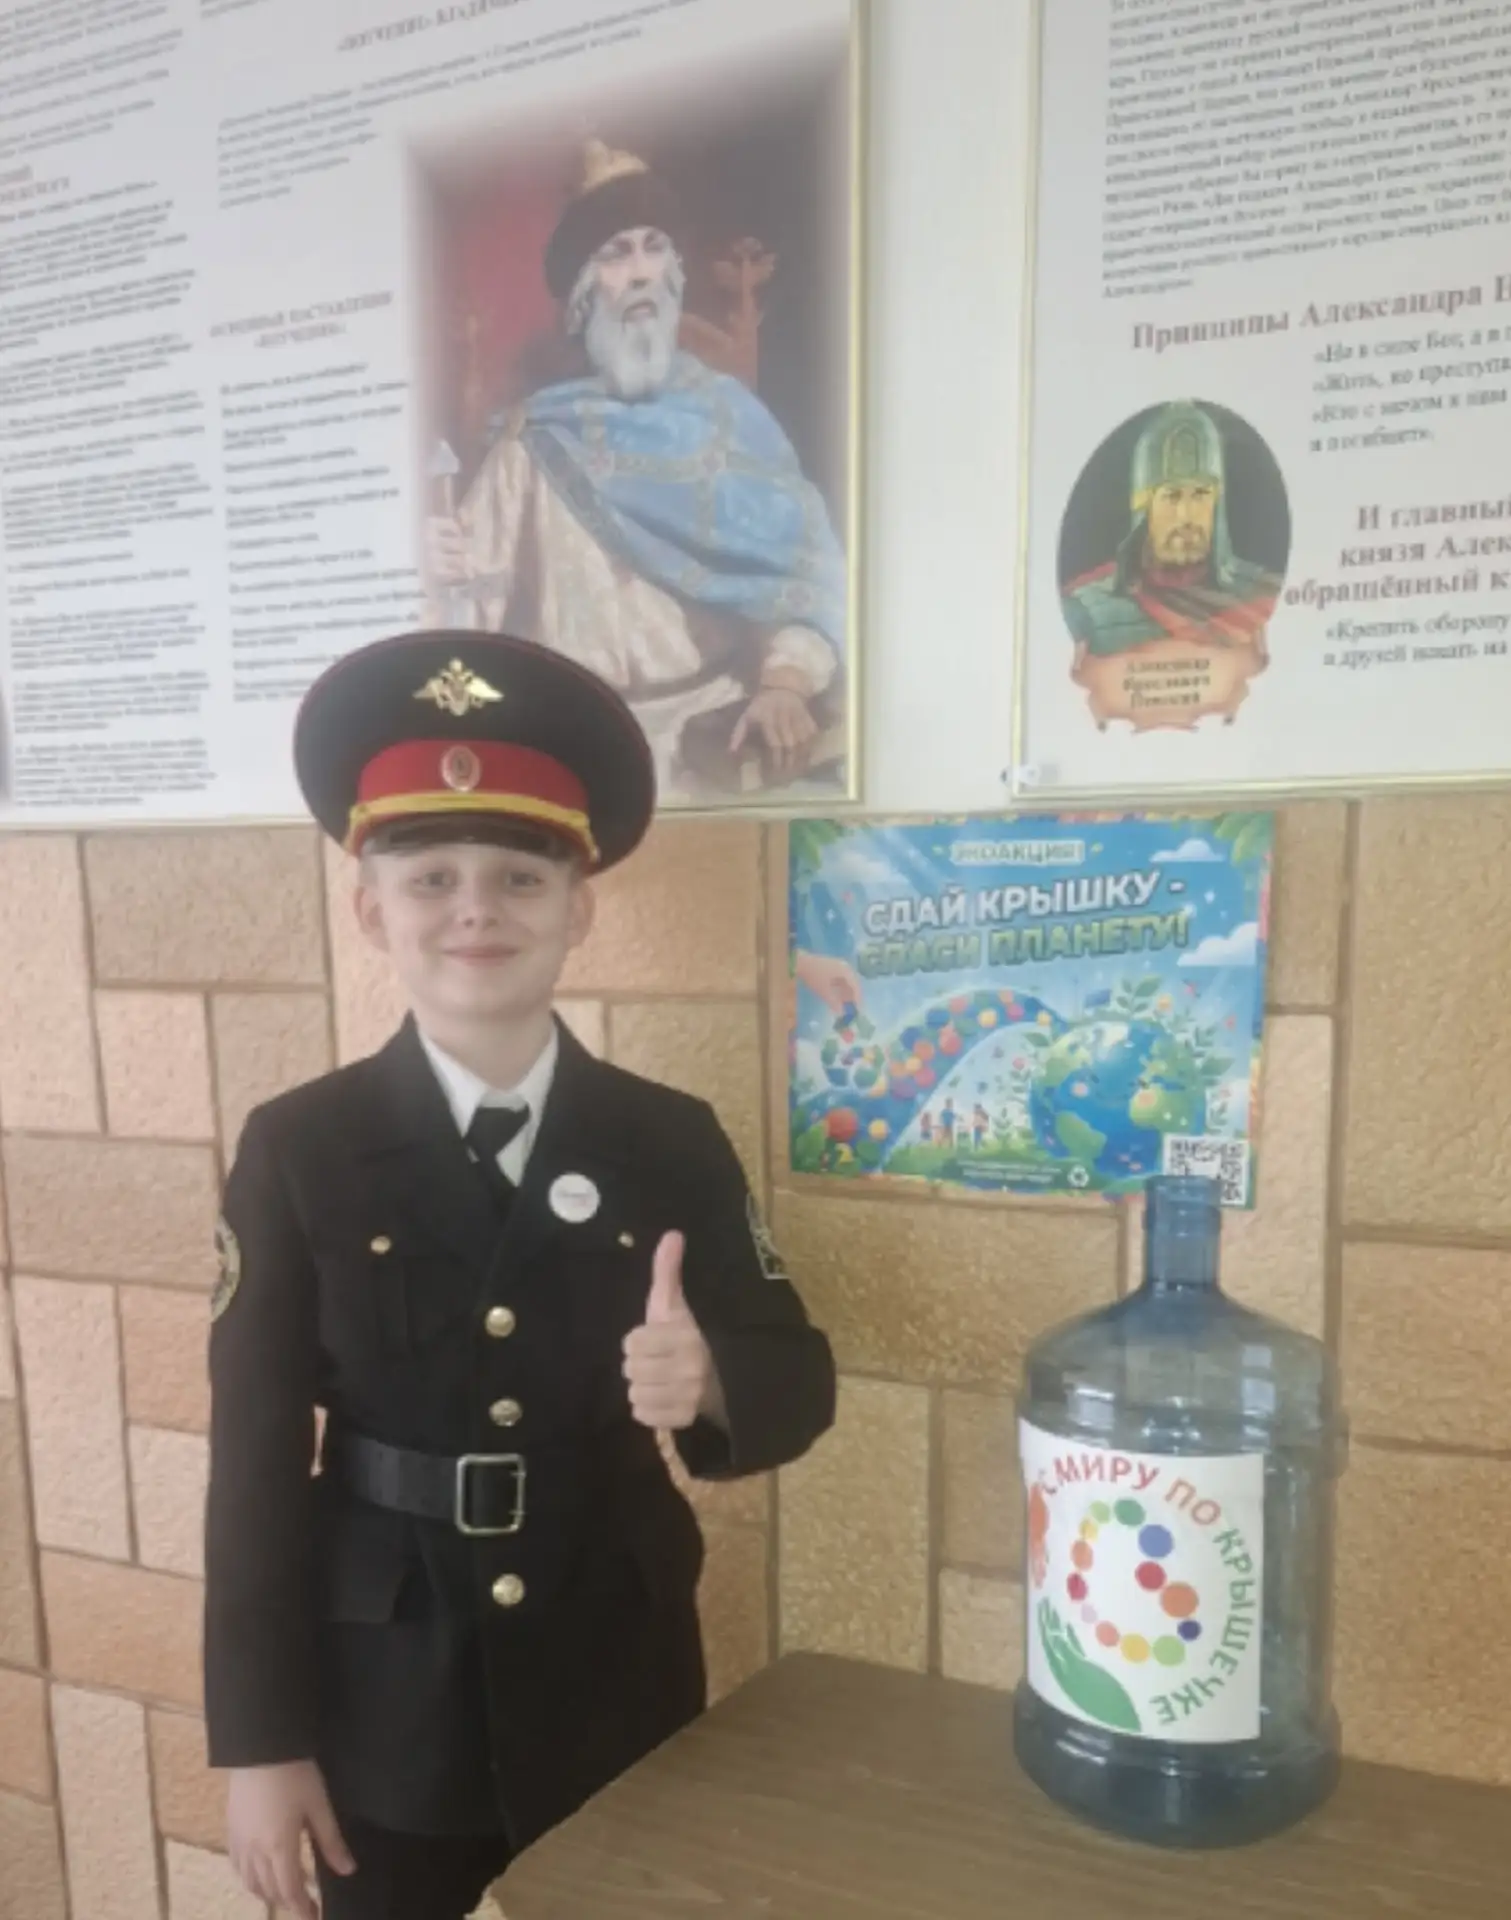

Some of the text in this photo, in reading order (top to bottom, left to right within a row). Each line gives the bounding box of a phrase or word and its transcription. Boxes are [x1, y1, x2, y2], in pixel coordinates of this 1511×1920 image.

[1132, 310, 1290, 353] Принципы
[1300, 285, 1483, 328] Александра
[1357, 504, 1381, 530] И
[1339, 541, 1425, 567] князя
[1284, 565, 1479, 610] обращённый
[861, 883, 968, 937] СДАЙ
[973, 869, 1161, 926] КРЫШКУ
[855, 907, 1191, 980] СПАСИ ПЛАНЕТУ!
[1052, 1451, 1161, 1491] МИРУ
[1163, 1476, 1224, 1527] ПО
[1148, 1527, 1257, 1726] КРЫШЕЧКЕ
